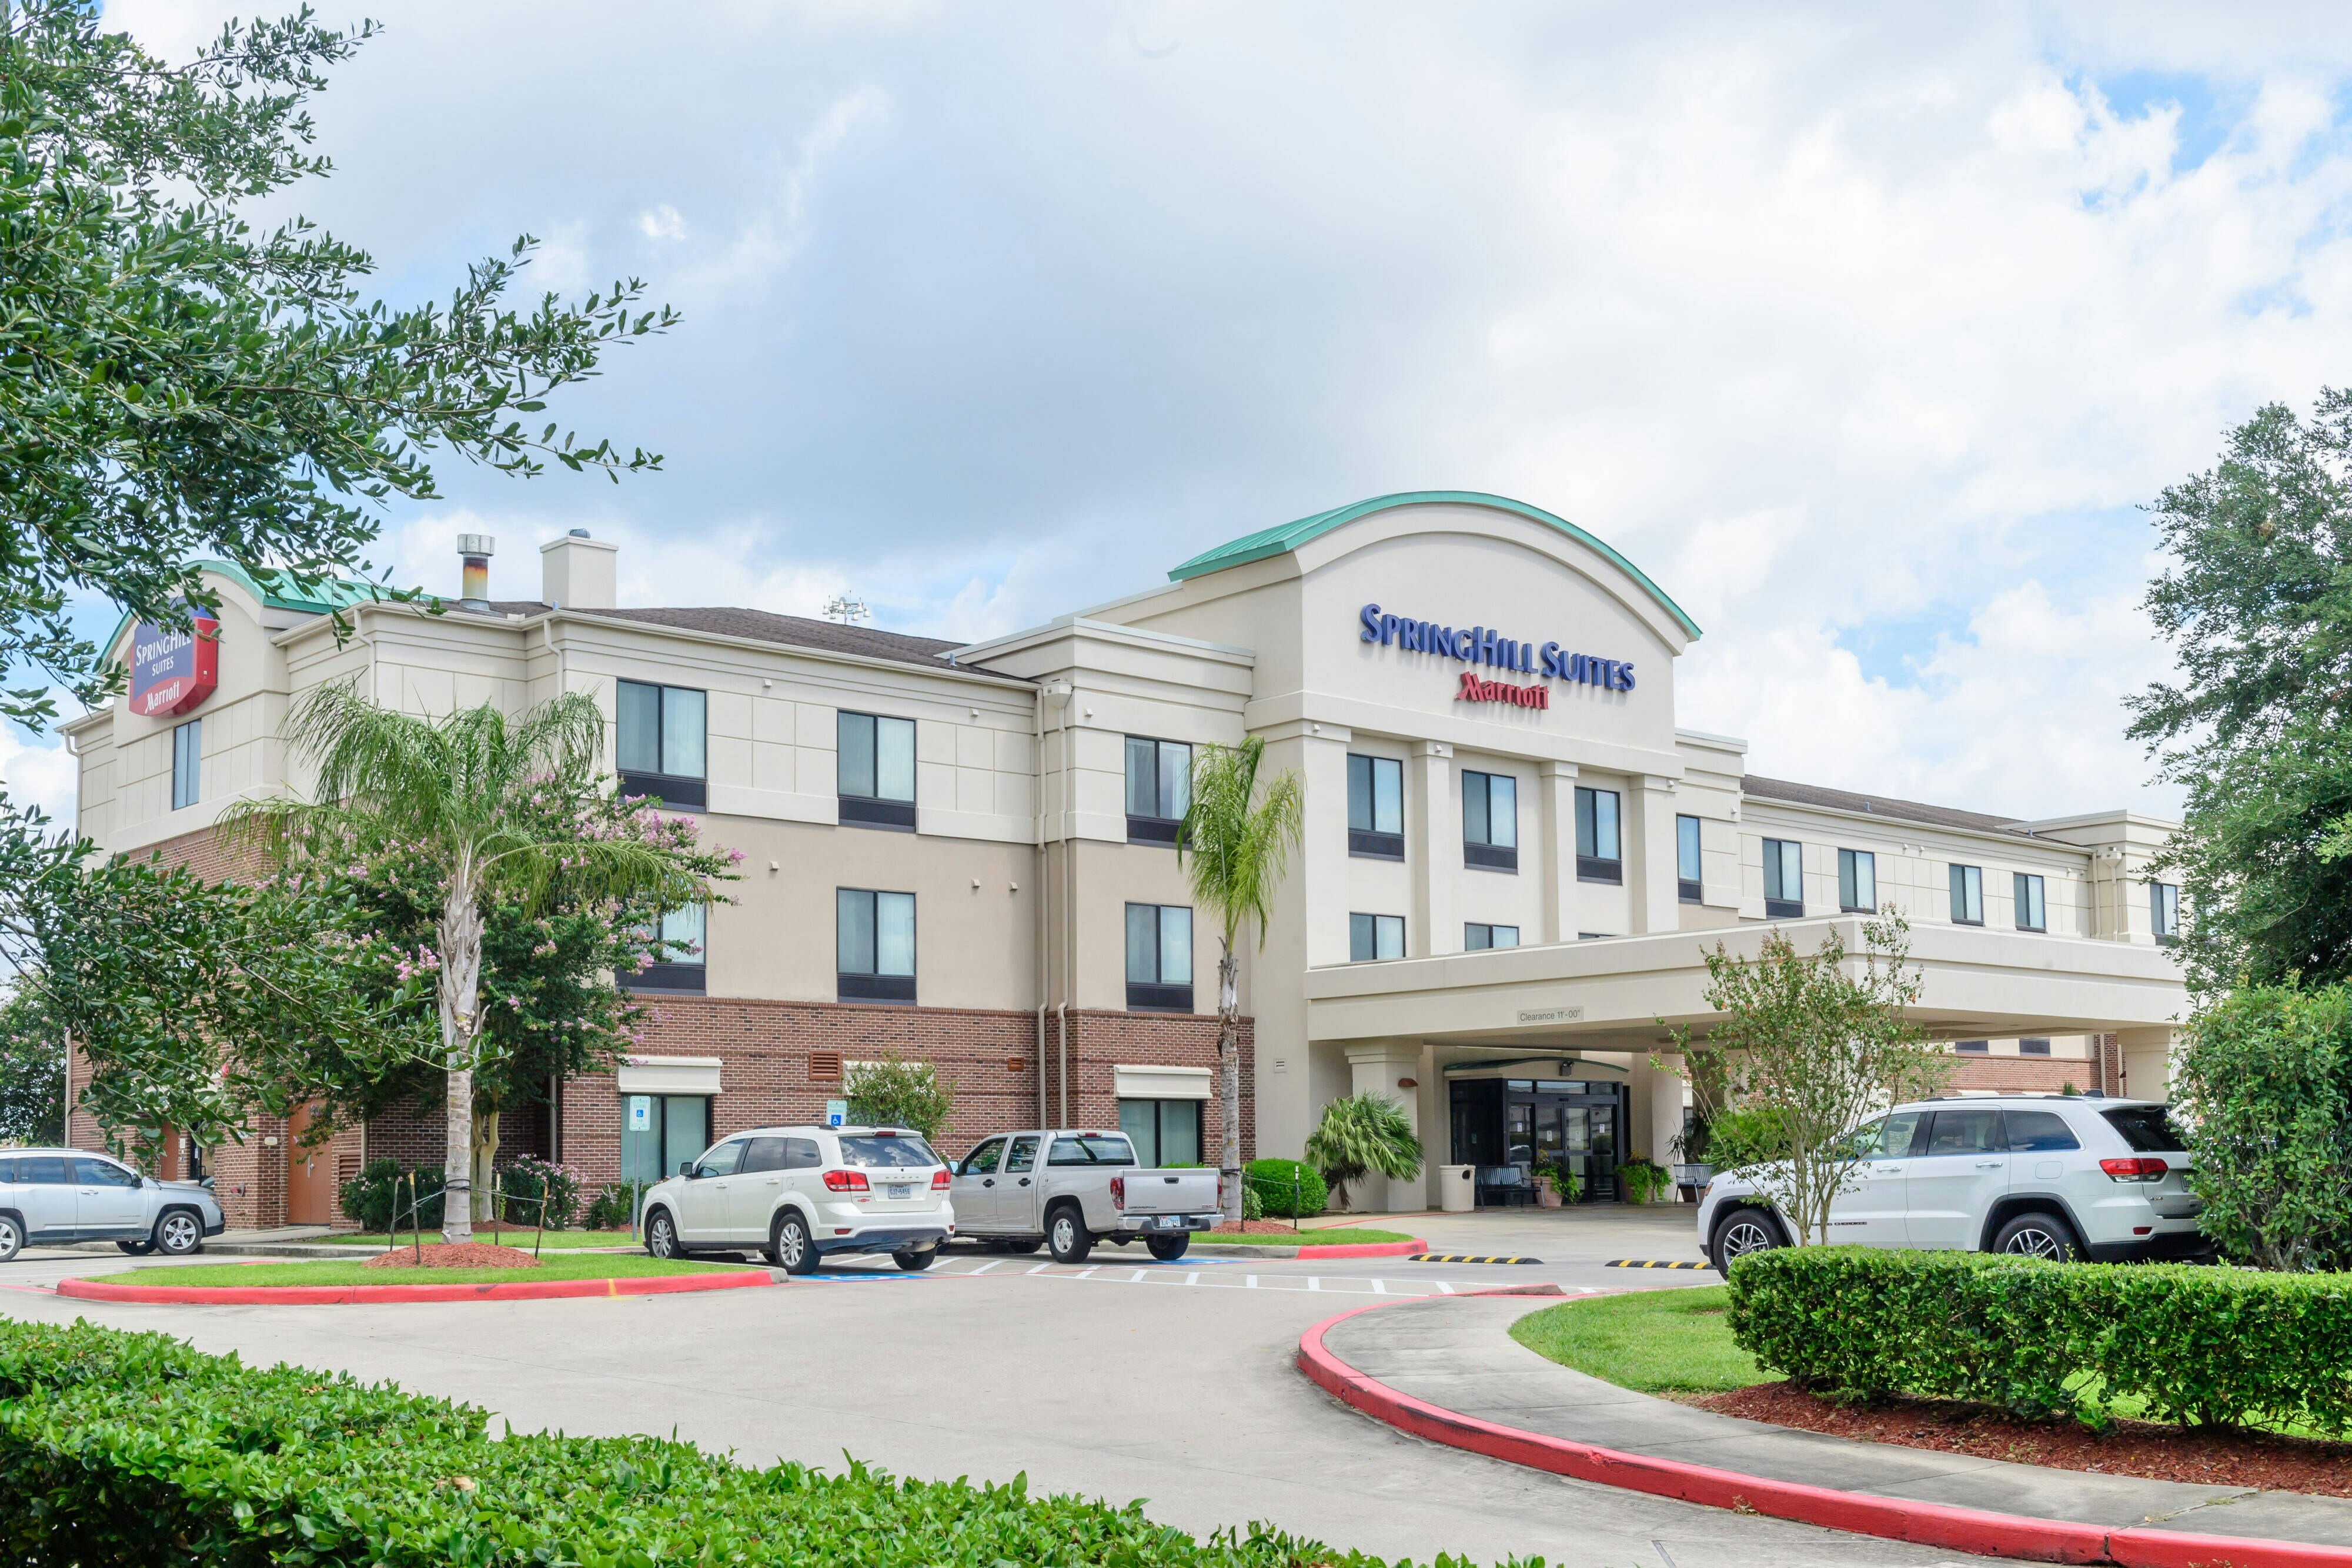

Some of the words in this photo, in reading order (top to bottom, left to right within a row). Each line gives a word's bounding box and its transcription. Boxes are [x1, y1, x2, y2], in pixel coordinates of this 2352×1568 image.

[1361, 603, 1538, 674] SPRINGHILL
[1541, 641, 1636, 691] SUITES
[152, 656, 174, 677] SUITES
[145, 680, 180, 714] Marriott
[1455, 671, 1549, 710] Marriott
[1519, 1012, 1555, 1022] Clearance
